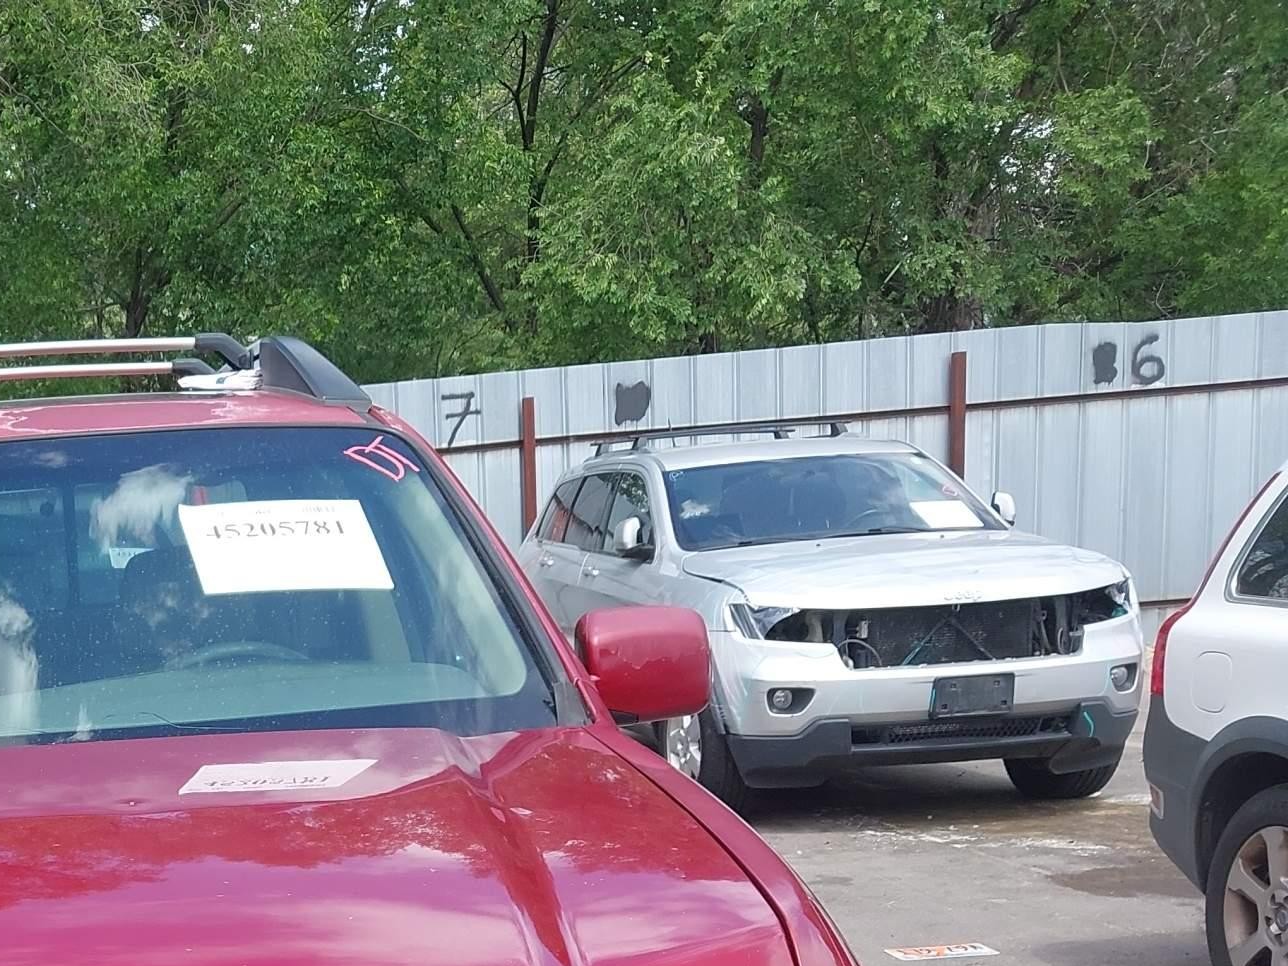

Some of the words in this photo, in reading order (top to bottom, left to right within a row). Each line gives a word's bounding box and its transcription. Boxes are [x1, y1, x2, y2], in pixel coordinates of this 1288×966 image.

[1131, 333, 1165, 385] 6
[441, 391, 482, 448] 7
[206, 519, 345, 539] 45205781
